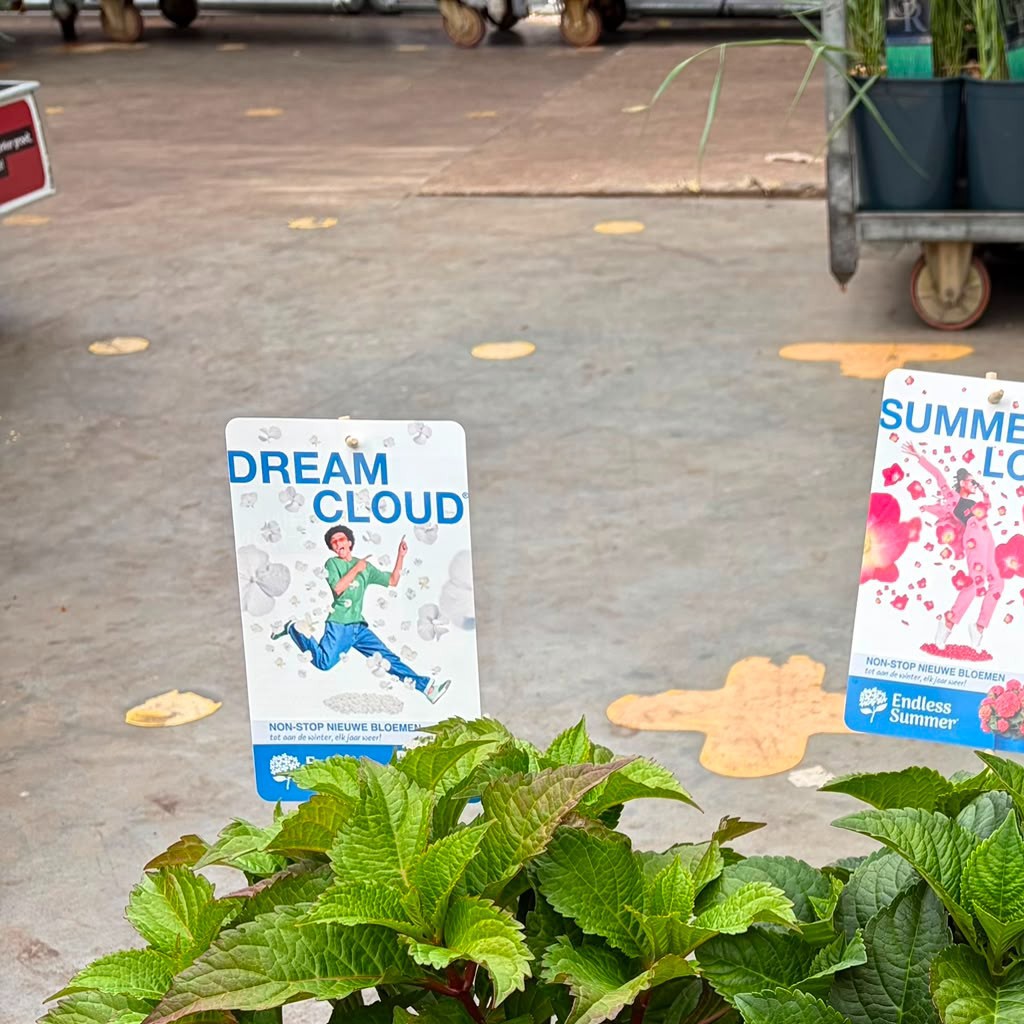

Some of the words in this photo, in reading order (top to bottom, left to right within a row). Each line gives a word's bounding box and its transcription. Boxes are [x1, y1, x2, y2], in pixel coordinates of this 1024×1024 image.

[227, 450, 389, 485] DREAM
[313, 489, 465, 525] CLOUD
[865, 656, 916, 671] NON-STOP
[918, 663, 957, 677] NIEUWE
[958, 668, 1006, 682] BLOEMEN
[892, 692, 952, 714] Endless
[269, 722, 324, 732] NON-STOP
[326, 723, 368, 732] NIEUWE
[889, 709, 957, 730] Summer
[269, 733, 282, 741] tot
[297, 733, 307, 741] de
[334, 733, 345, 741] elk
[345, 734, 361, 743] jaar
